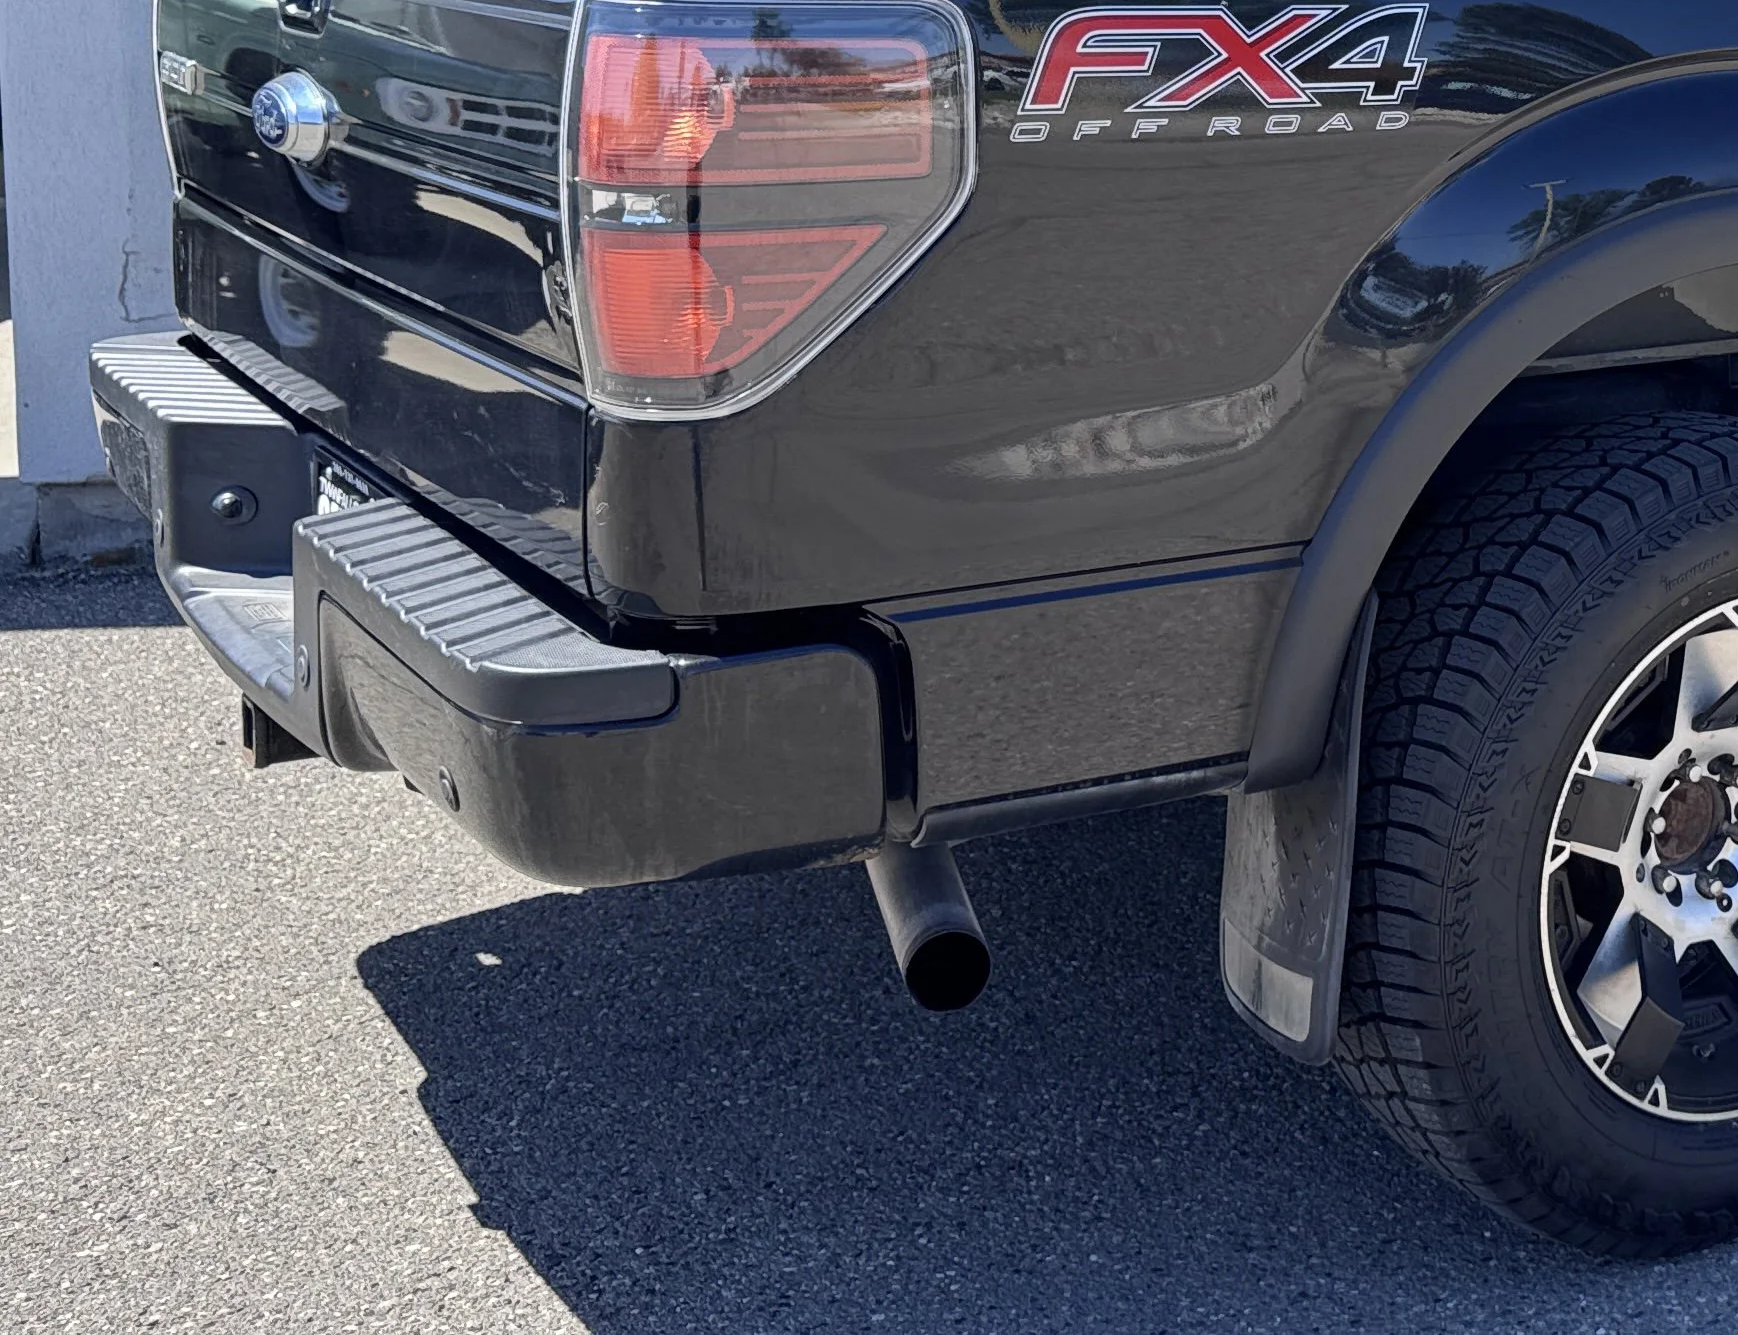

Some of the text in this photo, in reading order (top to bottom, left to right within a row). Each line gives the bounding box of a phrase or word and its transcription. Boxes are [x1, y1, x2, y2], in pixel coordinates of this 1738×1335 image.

[1017, 3, 1430, 115] FX4
[1009, 111, 1411, 143] OFF ROAD
